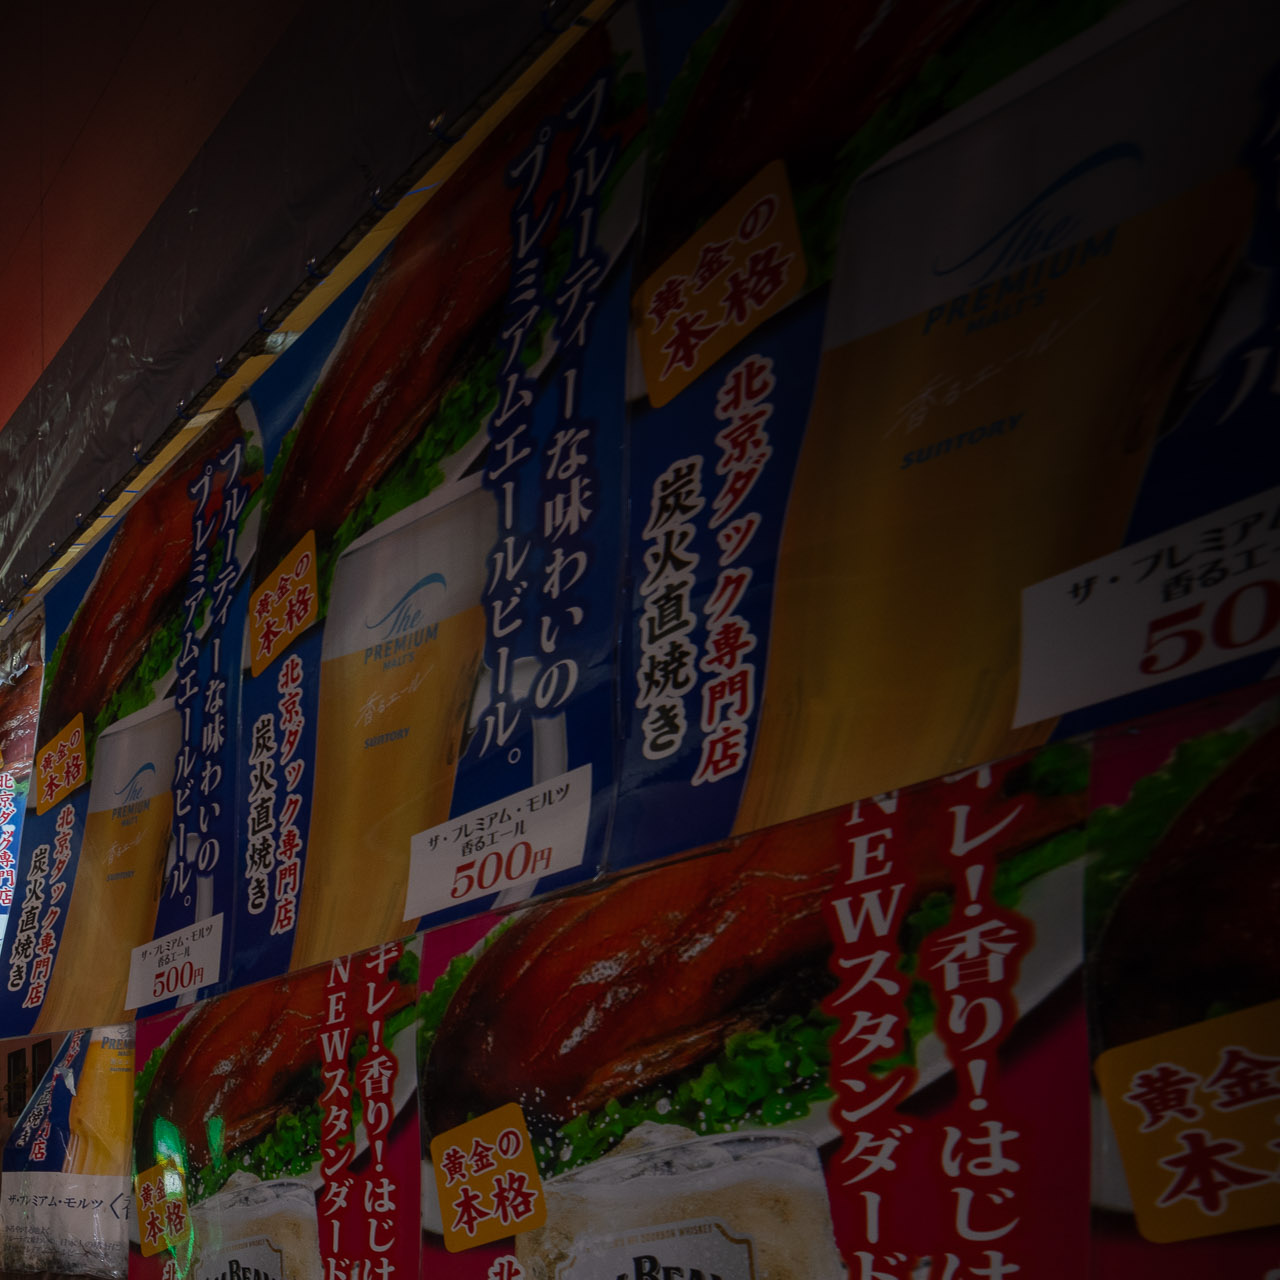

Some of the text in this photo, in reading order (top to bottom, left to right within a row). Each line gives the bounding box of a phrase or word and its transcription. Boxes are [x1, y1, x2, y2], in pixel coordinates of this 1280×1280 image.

[648, 194, 777, 334] 黄金の
[922, 225, 1119, 337] PREMIUM
[660, 242, 794, 382] 本格
[900, 412, 1025, 471] SUNTORY
[255, 550, 312, 622] 黄金の
[692, 354, 777, 787] 北京ダック専門店
[1067, 508, 1280, 606] ザ・プレミア
[257, 588, 316, 660] 本格
[640, 455, 706, 760] 炭火直焼き
[365, 623, 439, 665] PREMIUM
[364, 727, 410, 749] SUNTORY
[246, 717, 276, 915] 炭火直焼き
[272, 654, 304, 935] 北京ダック専門店
[428, 782, 571, 850] ザ・プレミアム・モルツ
[450, 841, 552, 899] 500円
[462, 819, 527, 857] 香るエール
[7, 844, 49, 992] 炭火直焼き
[24, 804, 75, 1009] 北京ダック専門店
[152, 960, 204, 998] 500円
[441, 1127, 523, 1187] 黄金の
[144, 1197, 186, 1246] 本格
[450, 1169, 540, 1236] 本格
